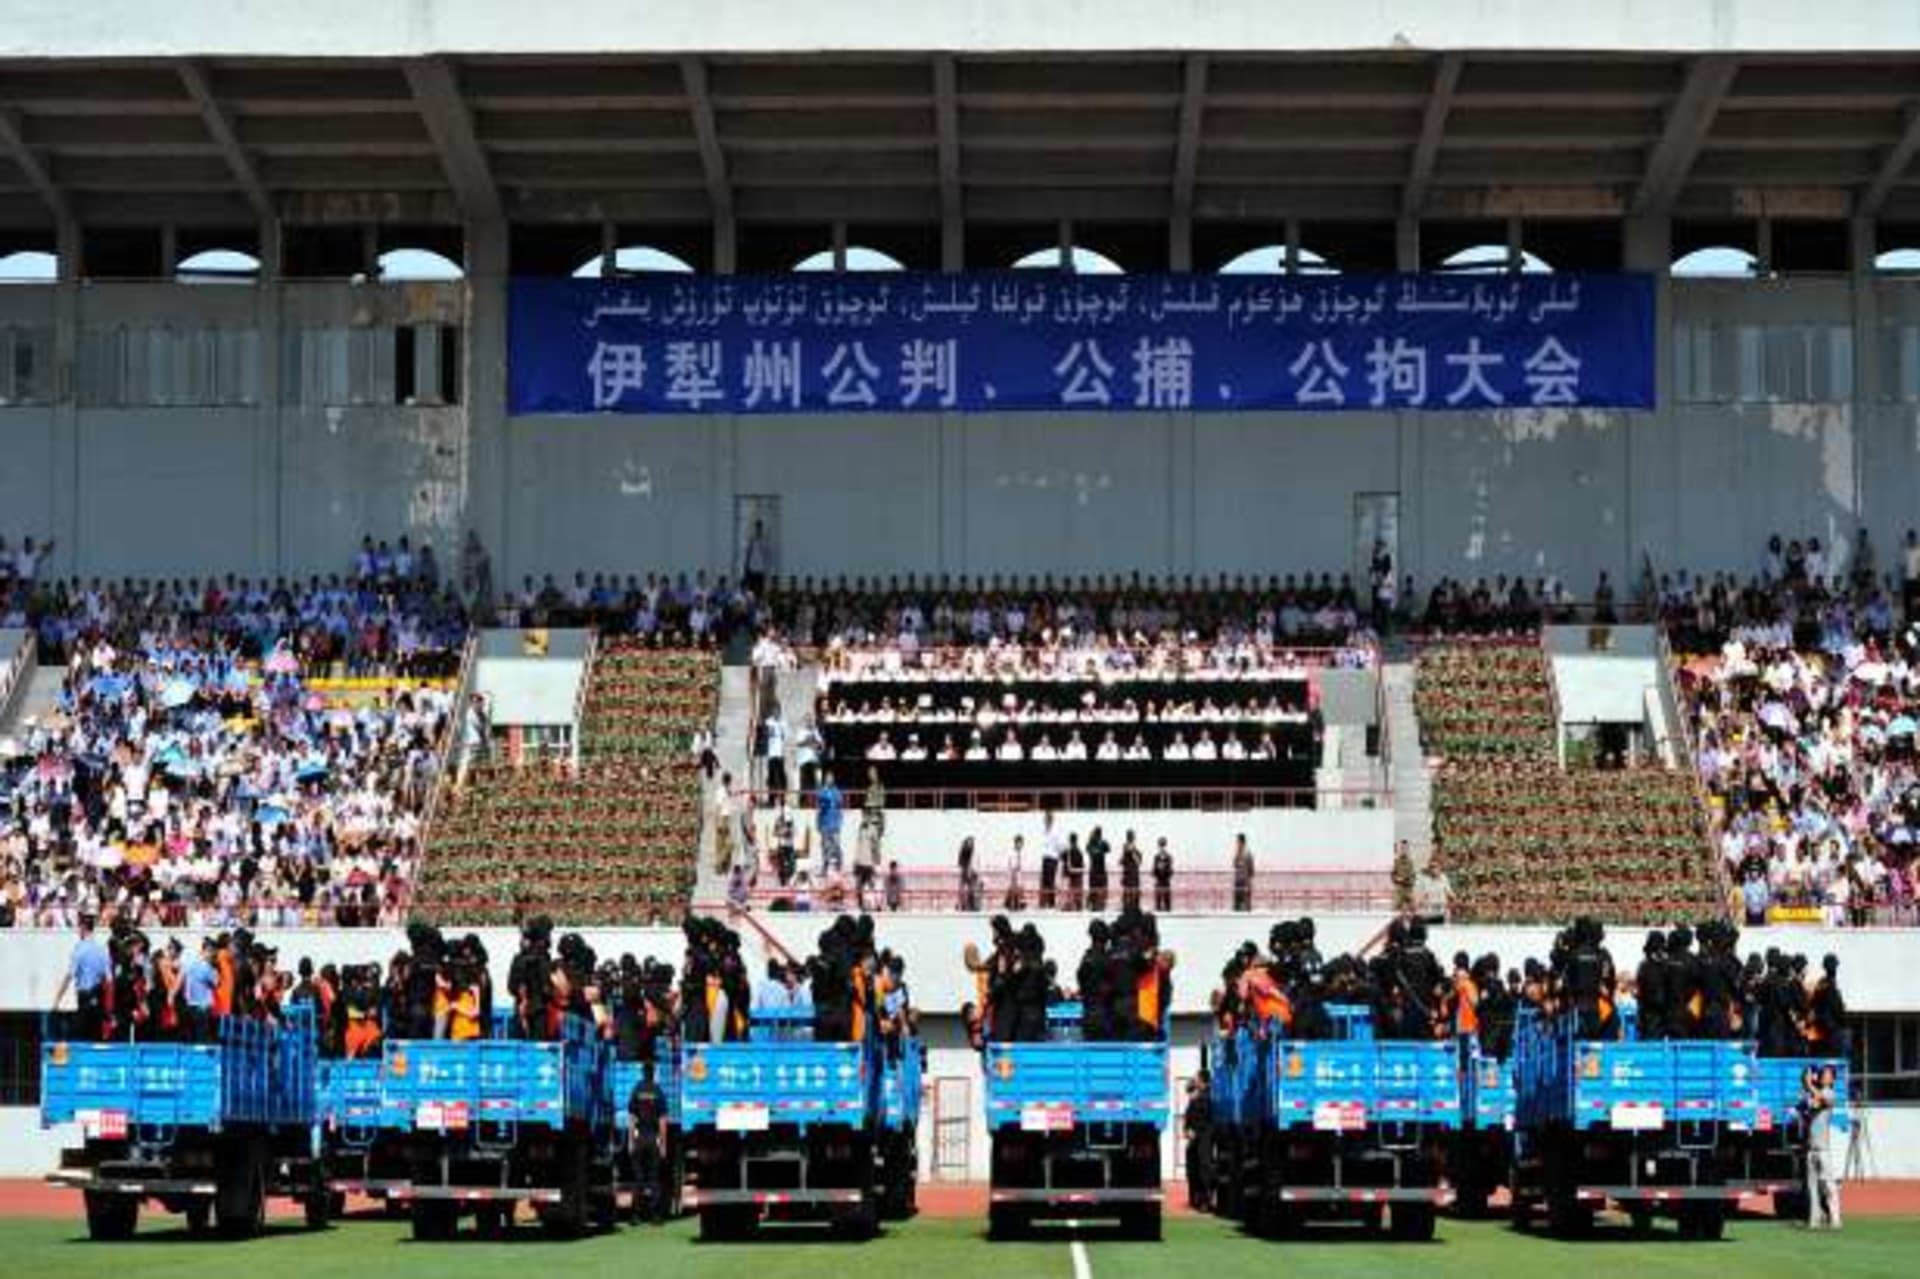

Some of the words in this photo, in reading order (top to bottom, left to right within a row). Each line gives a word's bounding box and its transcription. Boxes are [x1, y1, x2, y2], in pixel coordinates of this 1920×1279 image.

[991, 280, 1047, 325] قولغا
[1529, 281, 1580, 323] ئىلى
[587, 337, 1582, 408] 伊犁州公判、公捕、公拘大会
